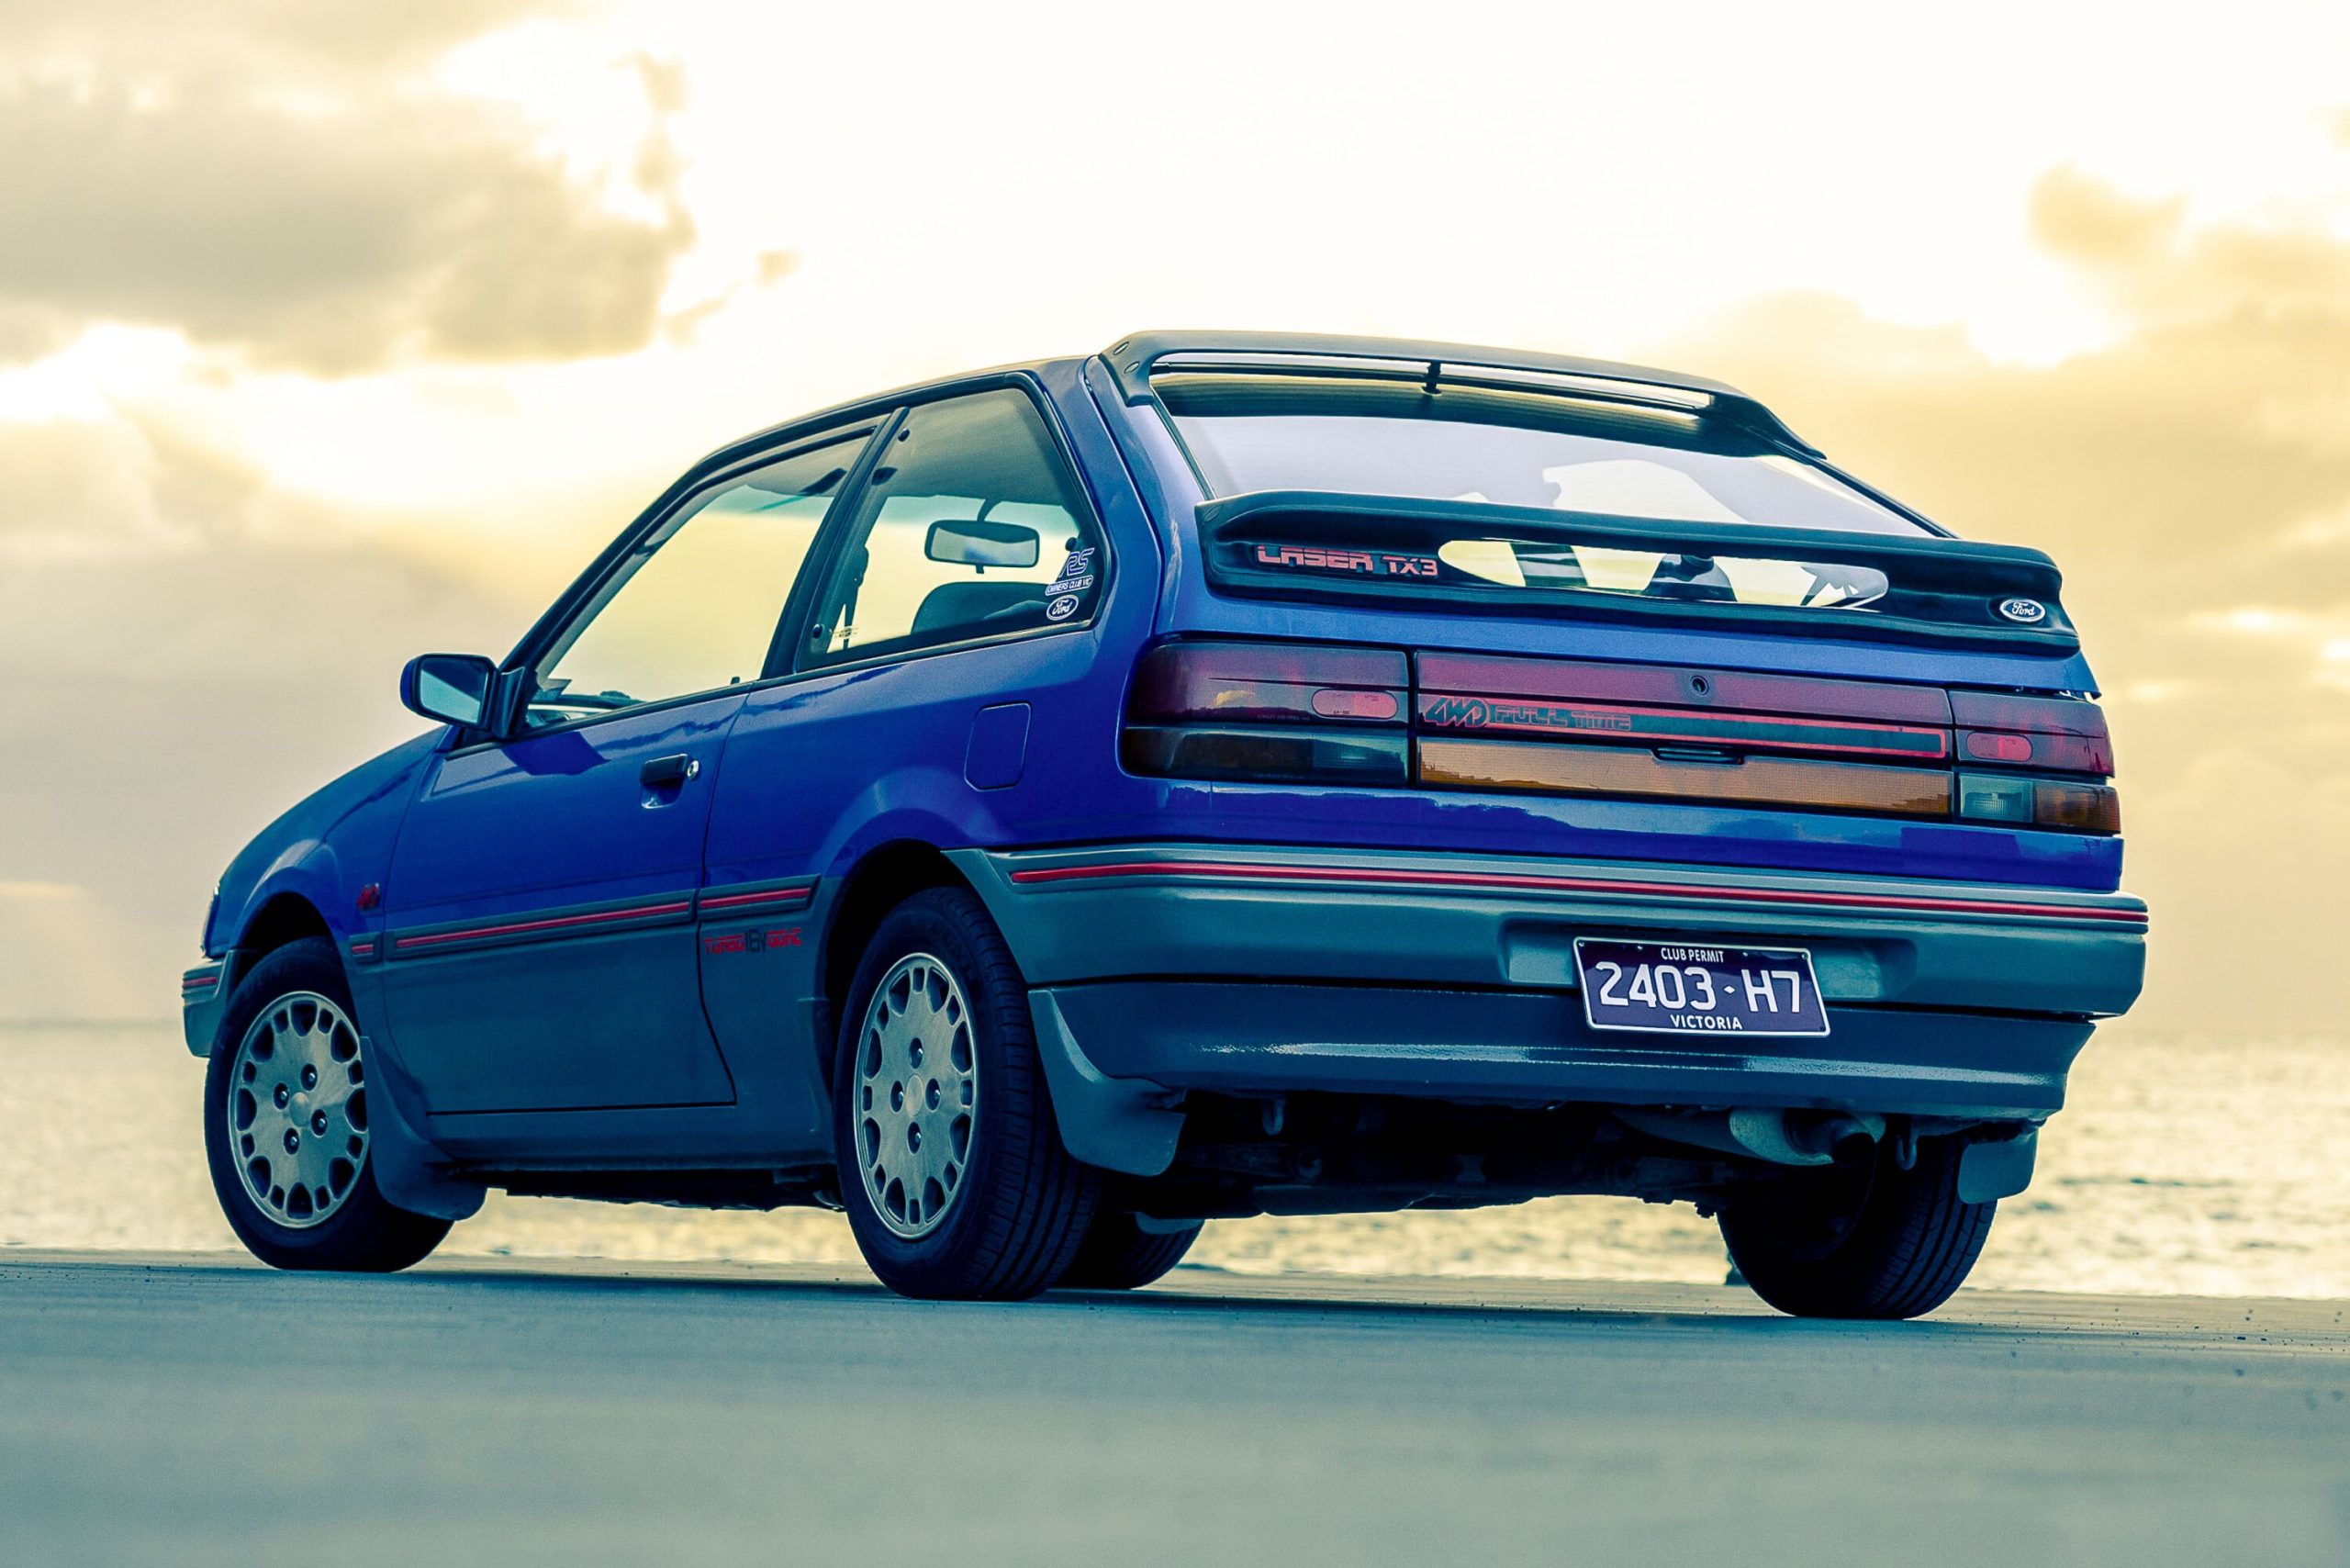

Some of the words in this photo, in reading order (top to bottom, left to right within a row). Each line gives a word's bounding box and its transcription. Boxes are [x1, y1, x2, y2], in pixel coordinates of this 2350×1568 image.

[1258, 544, 1373, 571] LASER
[1382, 555, 1438, 576] TX3
[1424, 695, 1490, 728] 4WD
[1494, 705, 1568, 727] FULL
[1571, 710, 1631, 732] TIME
[1661, 946, 1687, 961] CLUB
[1687, 949, 1725, 964] PERMIT
[1670, 1014, 1744, 1031] VICTORIA
